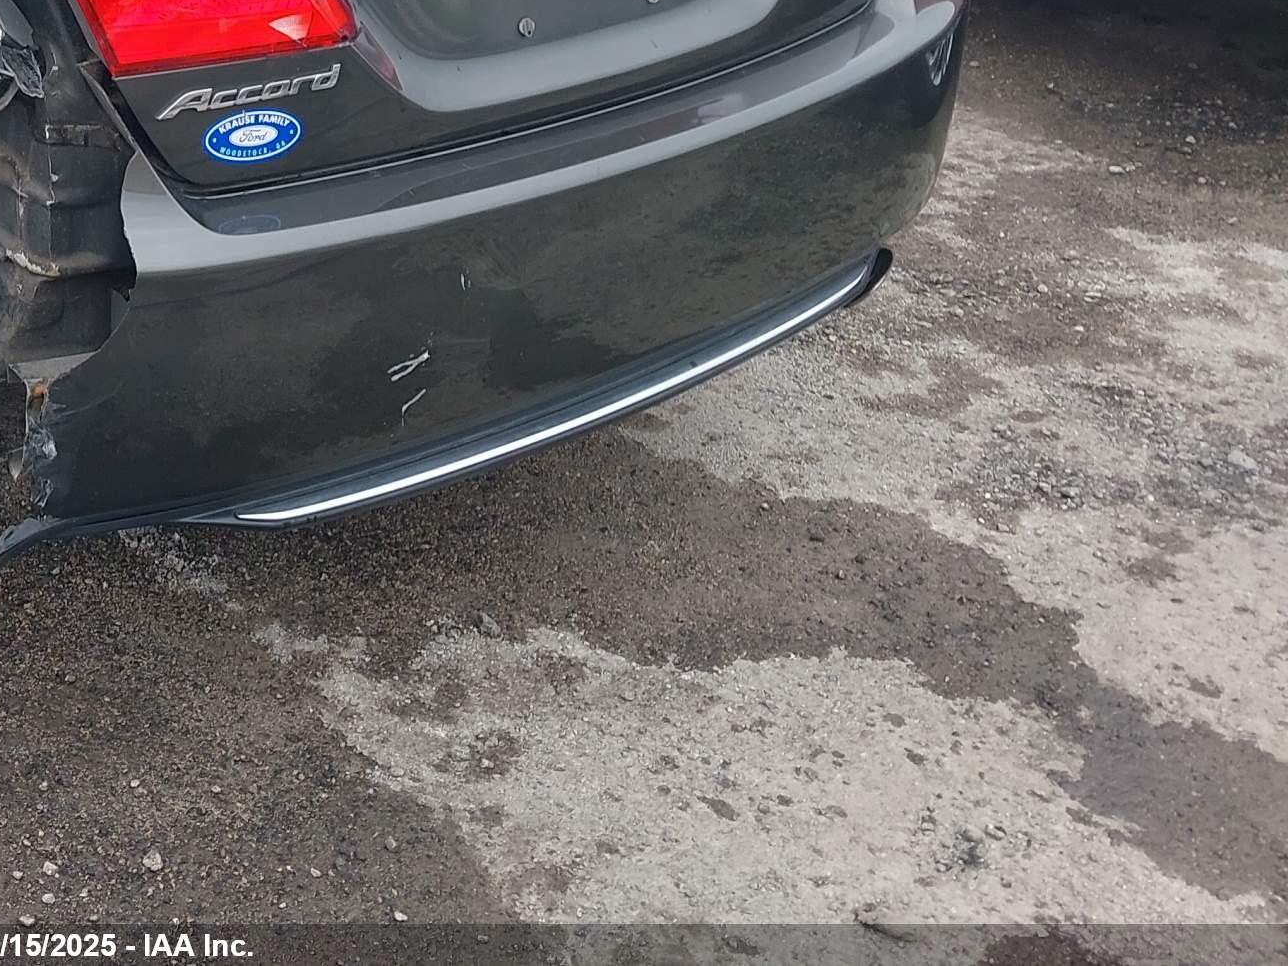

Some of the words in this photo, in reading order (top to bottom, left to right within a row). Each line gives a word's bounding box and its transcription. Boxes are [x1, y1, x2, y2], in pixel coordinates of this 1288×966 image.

[155, 63, 342, 121] Accord
[218, 114, 256, 134] KRAUSE
[258, 113, 291, 127] FAMILY
[238, 129, 269, 143] Ford
